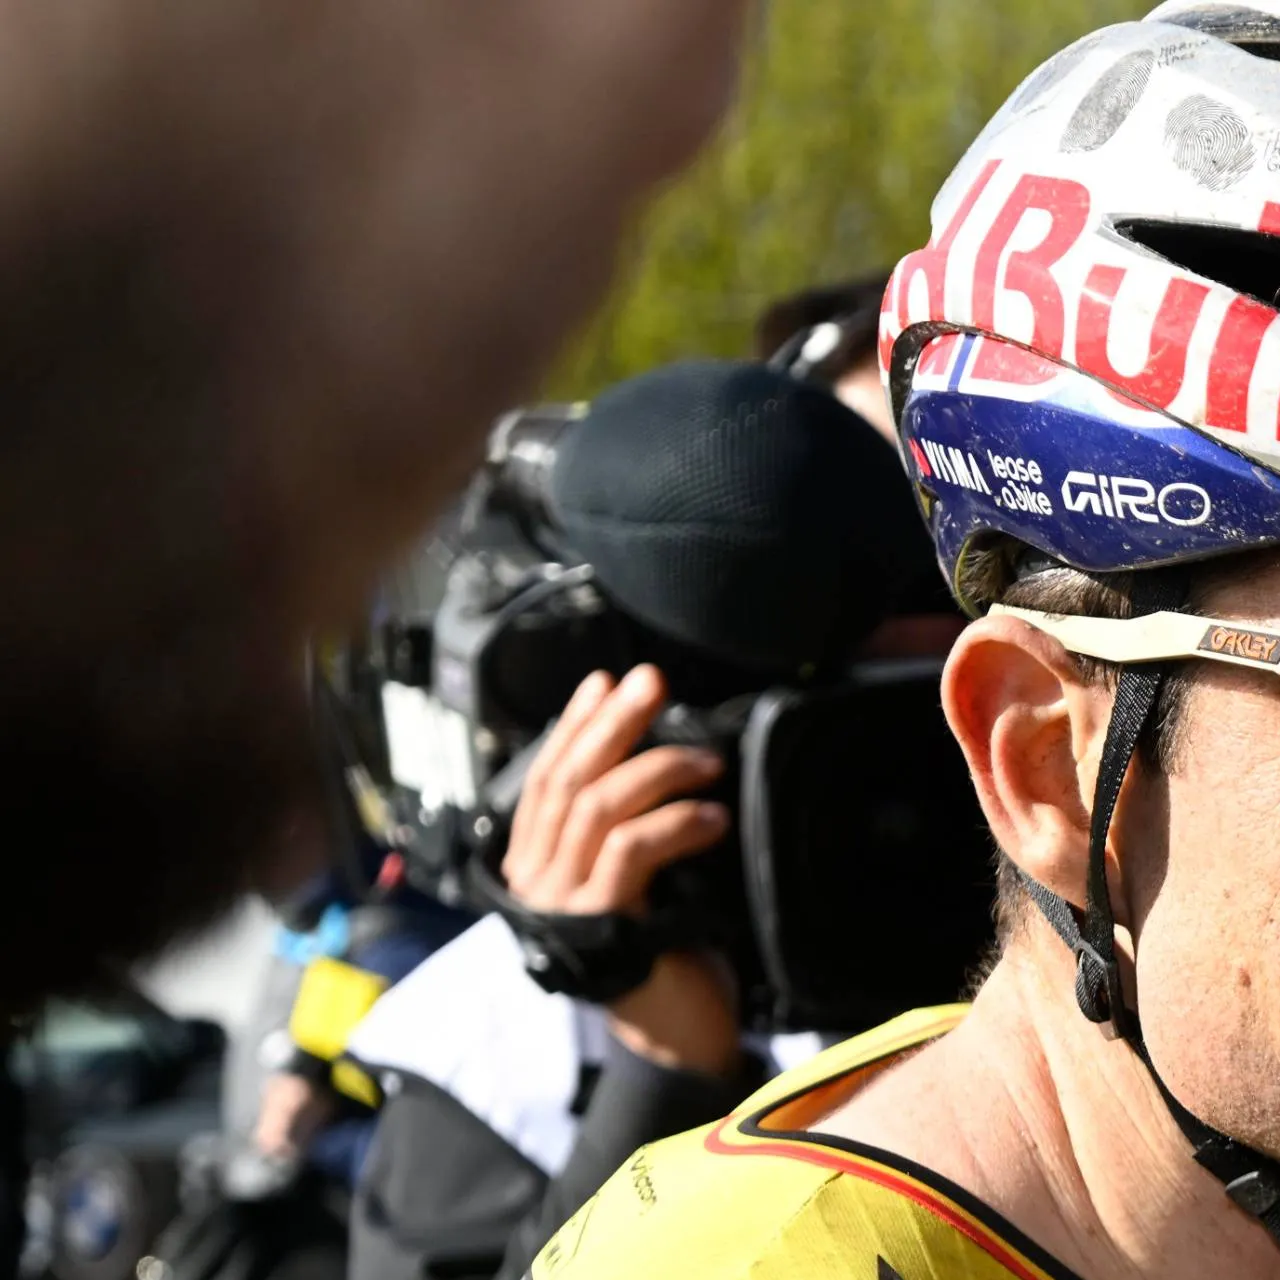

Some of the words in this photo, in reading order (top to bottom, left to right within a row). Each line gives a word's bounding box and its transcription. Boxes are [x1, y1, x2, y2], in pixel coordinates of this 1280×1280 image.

[921, 437, 992, 496] VISMA
[987, 448, 1043, 486] lease
[1061, 470, 1211, 527] GIRO
[1211, 627, 1279, 661] OAKLEY
